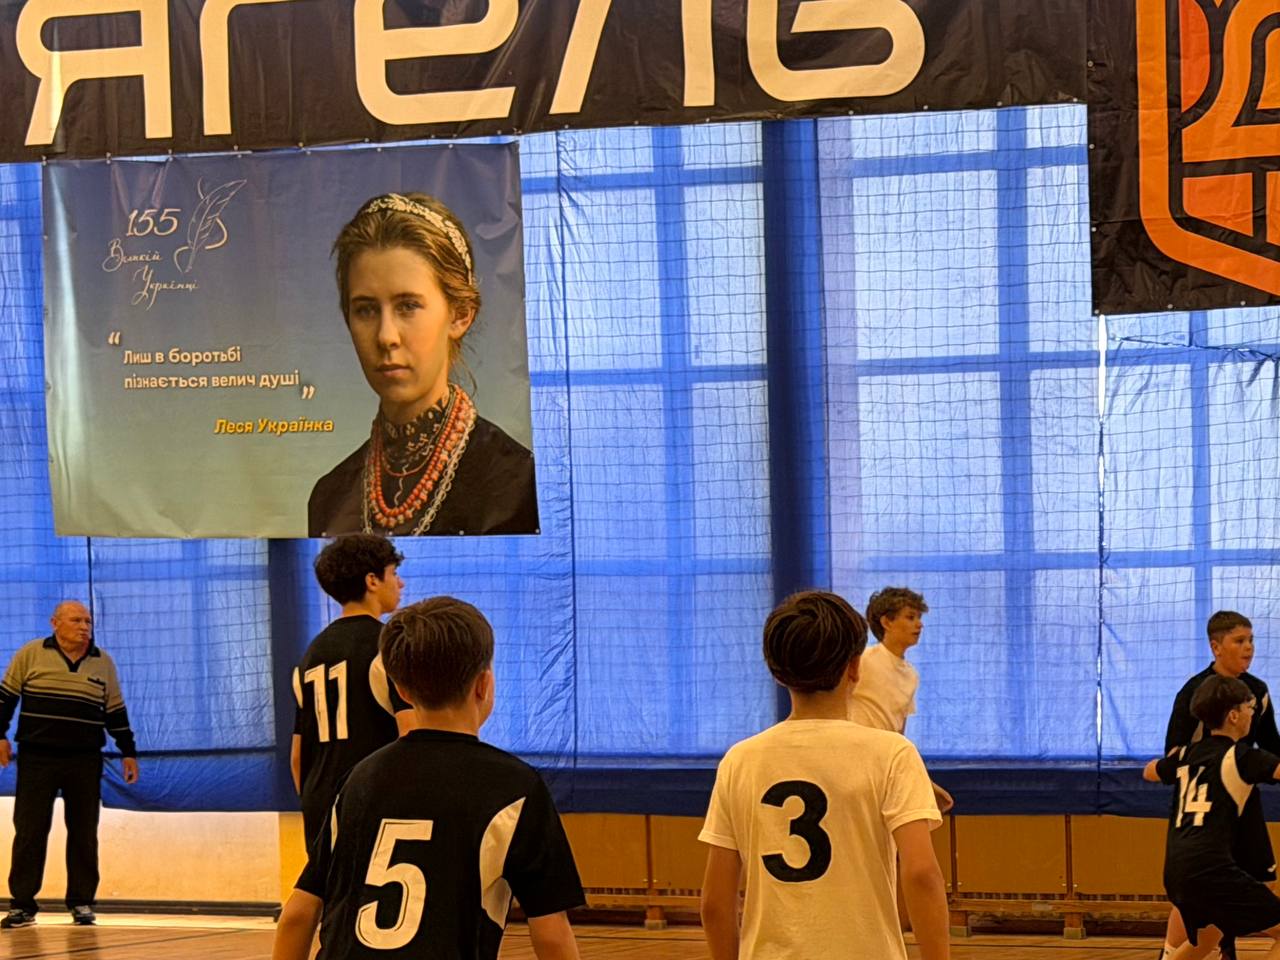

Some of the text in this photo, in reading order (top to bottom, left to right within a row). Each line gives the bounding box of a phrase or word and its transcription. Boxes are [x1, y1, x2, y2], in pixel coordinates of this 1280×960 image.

[126, 208, 181, 237] 155
[124, 346, 241, 366] Лиш в боротьбі
[124, 370, 299, 389] пізнається велич душі
[213, 416, 334, 436] Леся Українка
[304, 660, 348, 743] 11
[1175, 764, 1213, 828] 14
[760, 780, 833, 883] 3
[355, 818, 433, 950] 5
